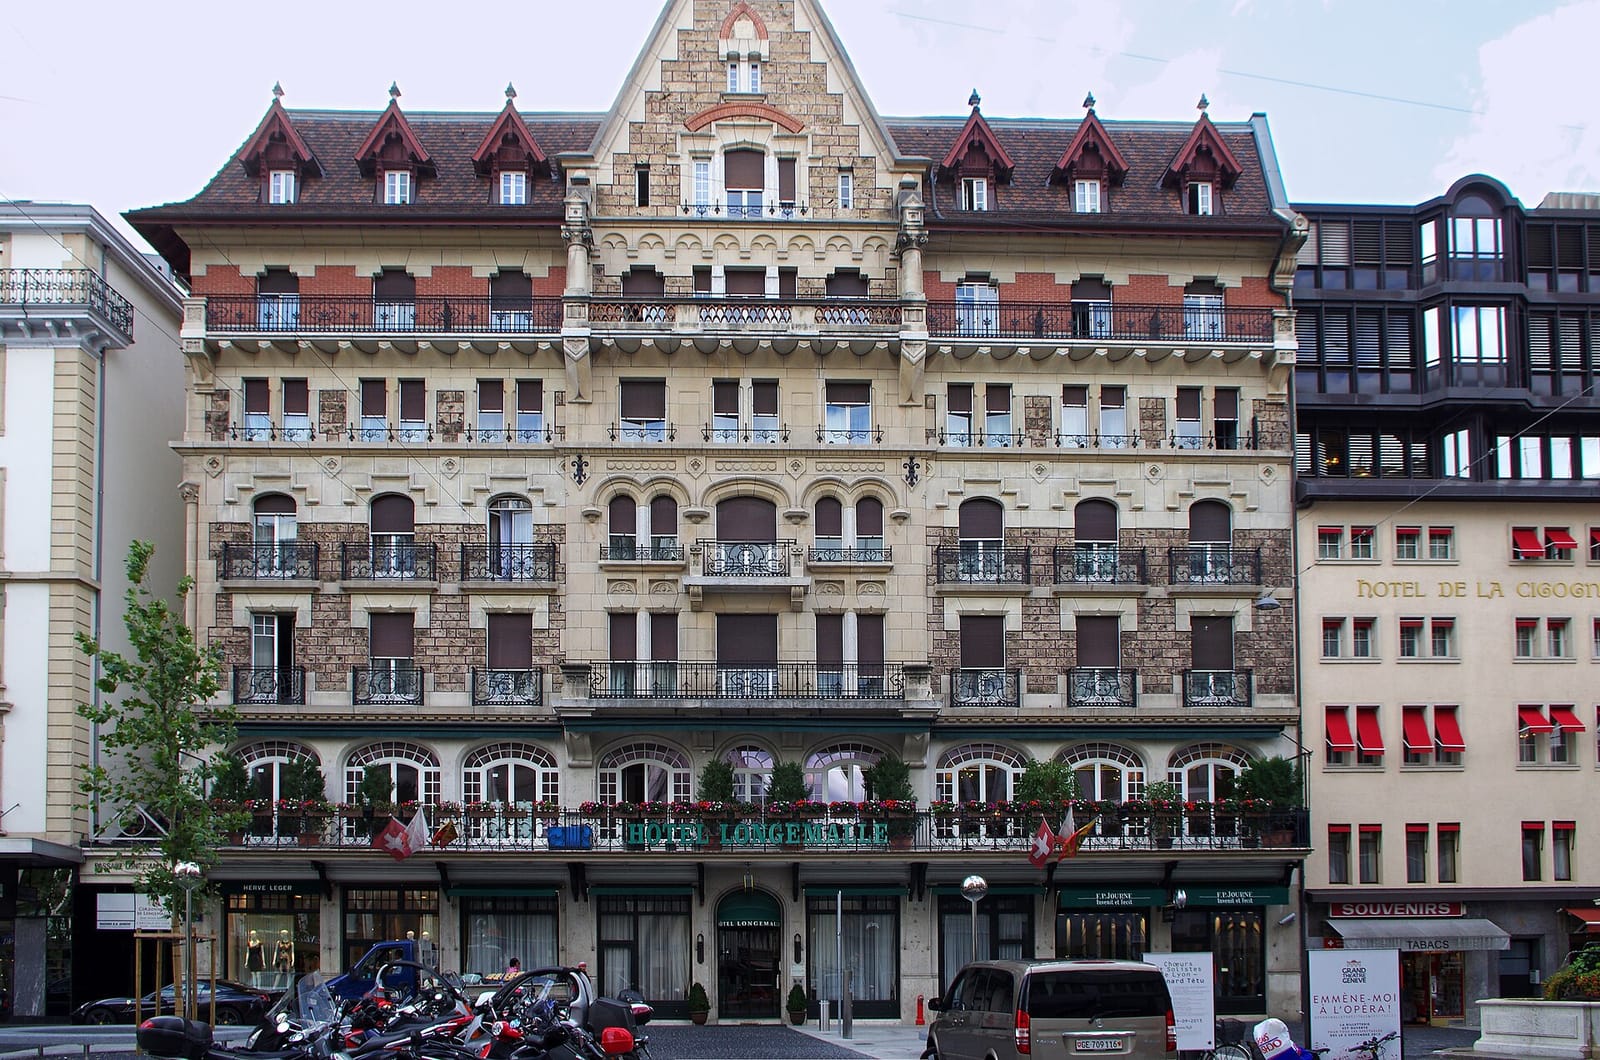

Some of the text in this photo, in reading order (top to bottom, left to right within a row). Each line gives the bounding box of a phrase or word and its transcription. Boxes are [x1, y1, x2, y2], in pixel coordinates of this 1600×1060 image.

[1438, 581, 1467, 598] DE
[1476, 581, 1505, 600] LA
[719, 822, 888, 844] LONGEMALLE
[1341, 902, 1451, 915] SOUVENIRS
[1407, 940, 1450, 949] TABACS
